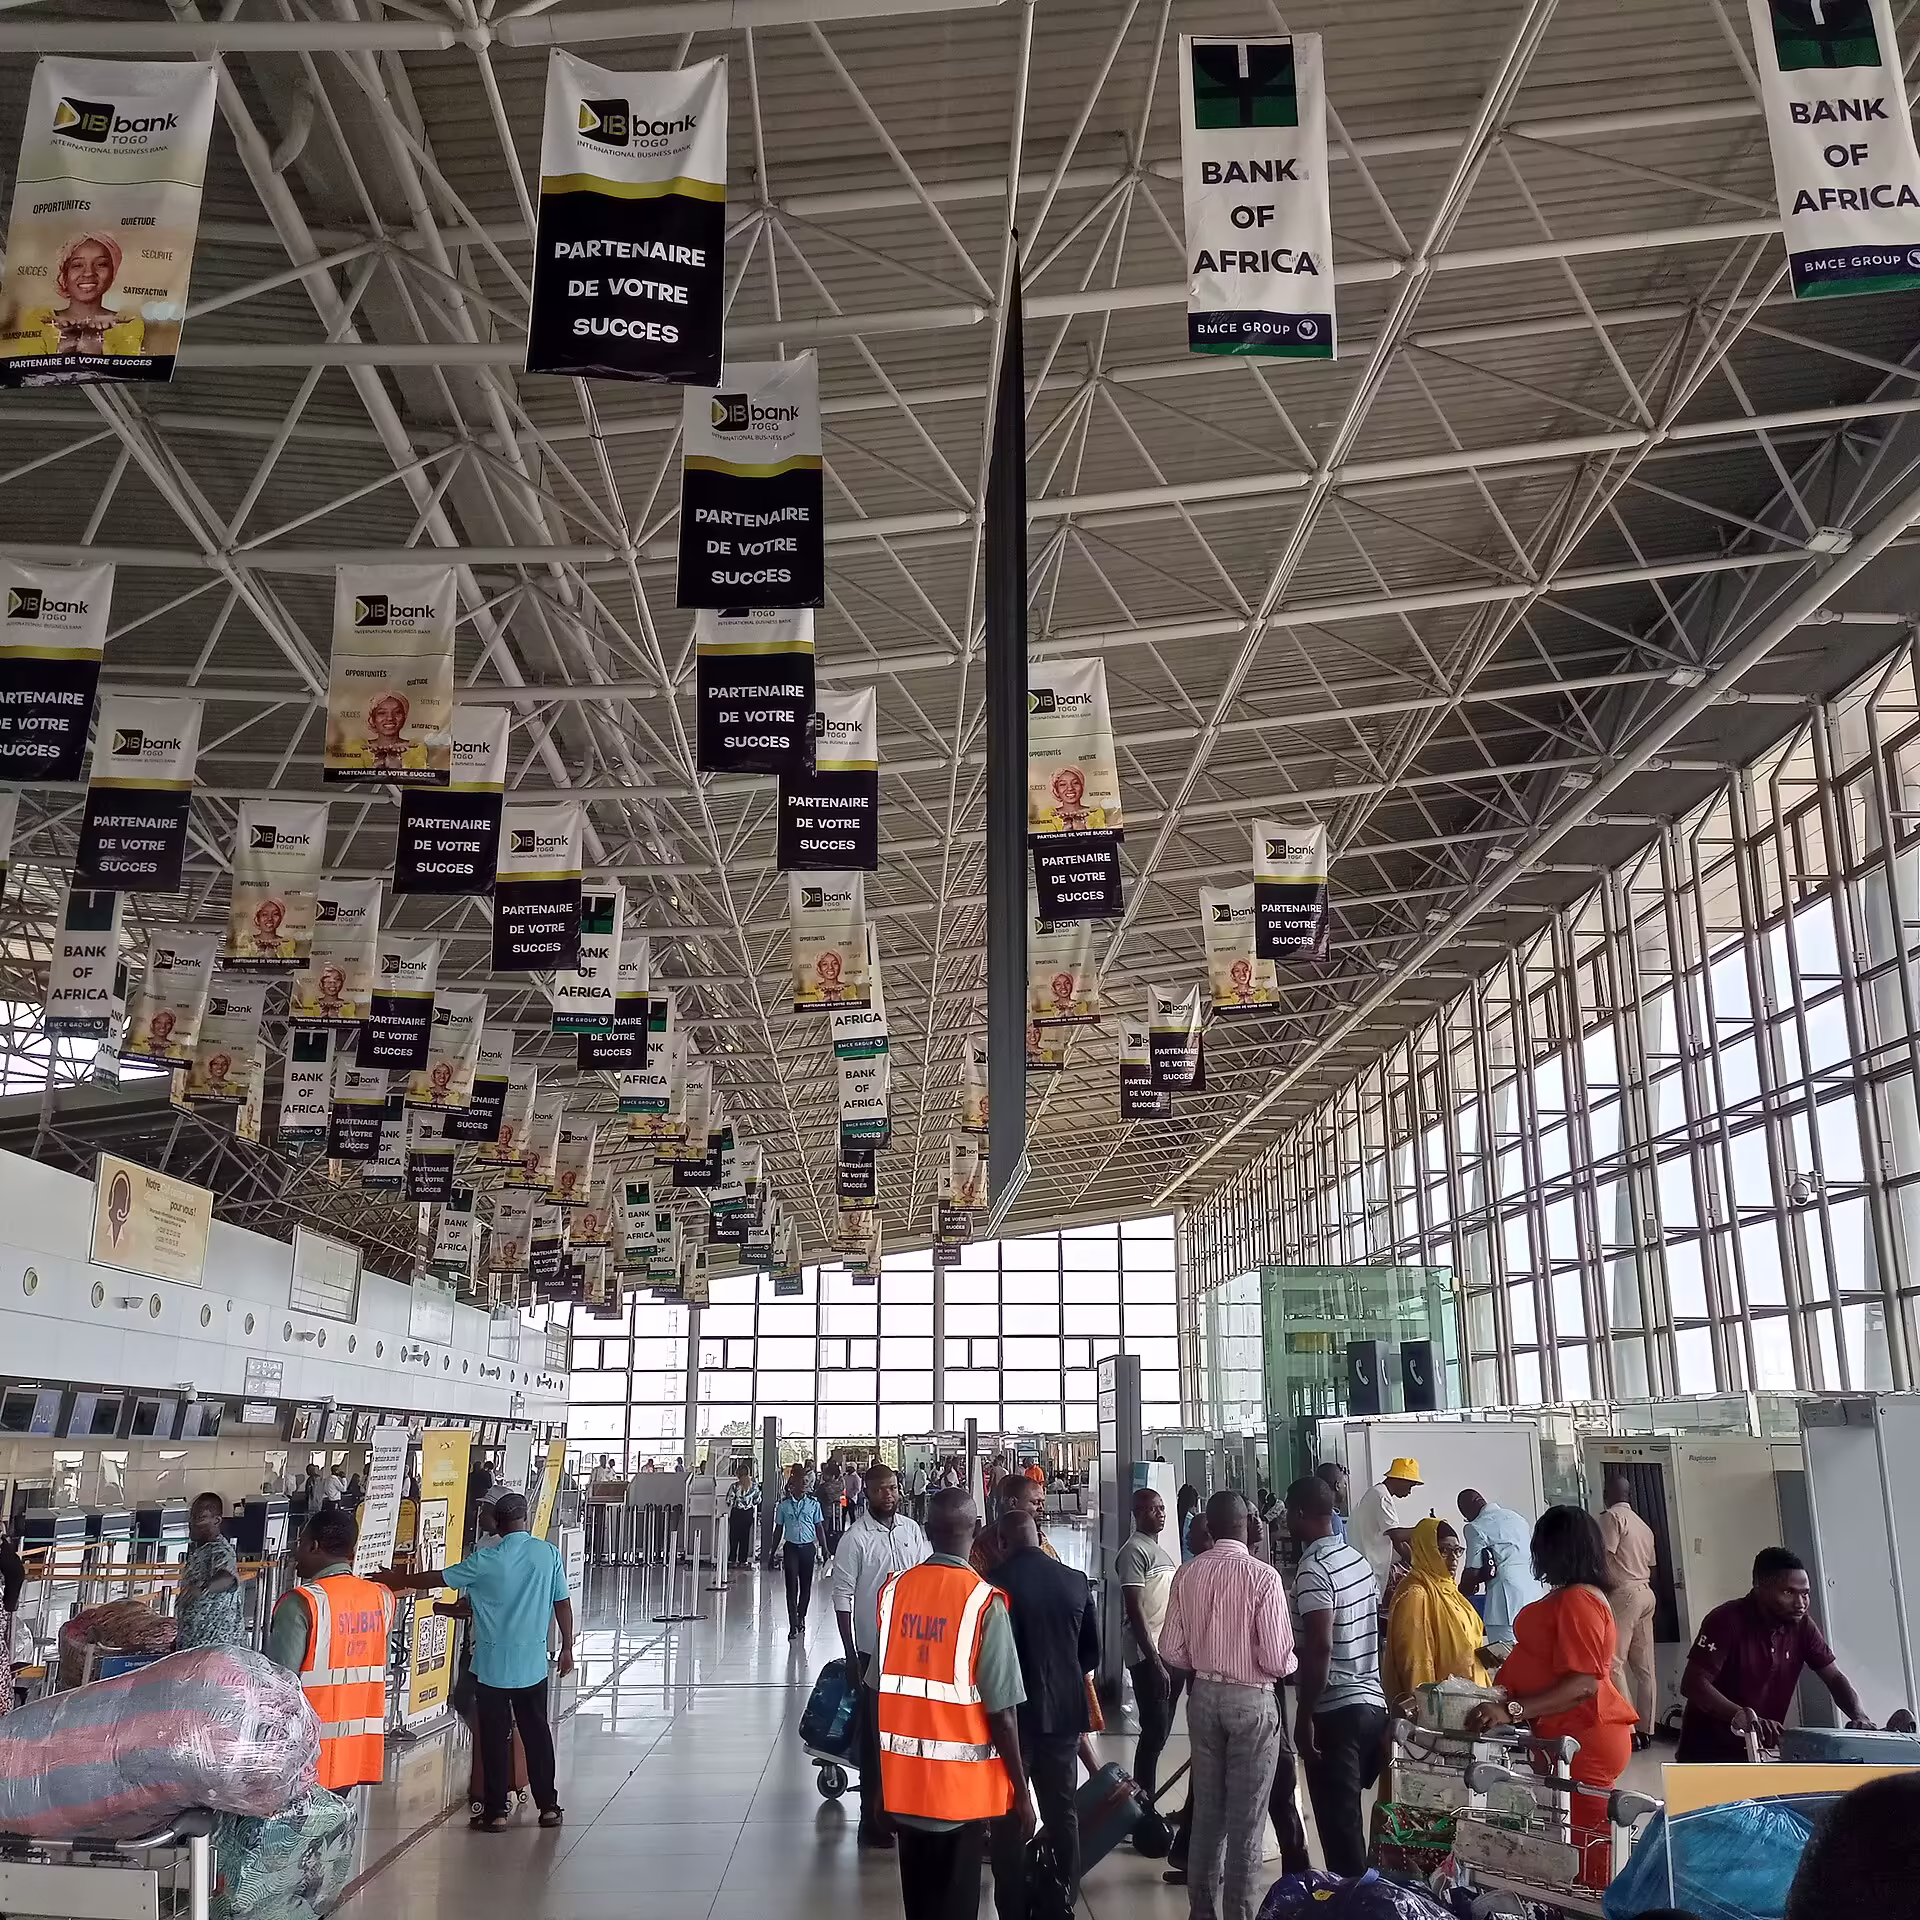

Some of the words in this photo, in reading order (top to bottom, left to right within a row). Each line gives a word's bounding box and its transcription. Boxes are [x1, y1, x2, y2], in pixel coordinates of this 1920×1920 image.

[1790, 98, 1889, 124] BANK
[112, 136, 147, 144] TOGO
[632, 139, 669, 147] TOGO
[50, 139, 112, 154] INTERNATIONAL
[576, 140, 634, 158] INTERNATIONAL
[636, 150, 672, 158] BUSINESS
[673, 144, 692, 154] BANK
[1824, 143, 1868, 167] OF
[1201, 158, 1298, 185] BANK
[1792, 184, 1920, 215] AFRICA
[1230, 205, 1274, 229] OF
[555, 240, 706, 268] PARTENAIRE
[1192, 249, 1319, 276] AFRICA
[1805, 259, 1846, 272] BMCE
[1852, 255, 1902, 267] GROUP
[123, 286, 168, 296] SATISFACTION
[568, 280, 598, 297] DE
[608, 278, 688, 305] VOTRE
[573, 317, 679, 344] SUCCES
[1198, 322, 1237, 334] BMCE
[1243, 321, 1290, 335] GROUP
[10, 358, 62, 368] PARTENAIRE
[65, 357, 76, 365] DE
[79, 357, 110, 365] VOTRE
[752, 423, 779, 431] TOGO
[696, 507, 809, 527] PARTENAIRE
[707, 540, 731, 555] DE
[738, 538, 797, 556] VOTRE
[711, 569, 792, 584] SUCCES
[42, 613, 67, 621] TOGO
[708, 685, 804, 698] PARTENAIRE
[0, 691, 84, 706] ARTENAIRE
[719, 712, 739, 723] DE
[744, 710, 794, 722] VOTRE
[17, 717, 70, 732] VOTRE
[724, 736, 790, 748] SUCCES
[788, 796, 868, 808] PARTENAIRE
[94, 816, 178, 830] PARTENAIRE
[407, 817, 491, 830] PARTENAIRE
[796, 818, 813, 829] DE
[817, 818, 860, 829] VOTRE
[98, 838, 116, 850] DE
[121, 839, 166, 852] VOTRE
[414, 839, 431, 850] DE
[436, 841, 480, 852] VOTRE
[800, 840, 856, 850] SUCCES
[1042, 852, 1111, 866] PARTENAIRE
[99, 862, 157, 873] SUCCES
[416, 862, 474, 874] SUCCES
[1051, 874, 1066, 884] DE
[1069, 871, 1106, 883] VOTRE
[1056, 891, 1104, 903] SUCCES
[502, 903, 573, 915] PARTENAIRE
[1262, 904, 1322, 913] PARTENAIRE
[509, 924, 524, 934] DE
[528, 922, 565, 933] VOTRE
[1268, 921, 1282, 929] DE
[1284, 921, 1316, 929] VOTRE
[1272, 936, 1314, 945] SUCCES
[64, 946, 107, 957] BANK
[512, 943, 561, 953] SUCCES
[72, 967, 93, 978] OF
[52, 988, 108, 1001] AFRICA
[558, 986, 612, 998] AFRICA
[368, 1015, 426, 1025] PARTENAIRE
[835, 1013, 882, 1026] AFRICA
[606, 1033, 635, 1041] VOTRE
[373, 1047, 413, 1056] SUCCES
[593, 1048, 632, 1056] SUCCES
[291, 1073, 323, 1082] BANK
[624, 1075, 667, 1084] AFRICA
[846, 1069, 876, 1079] BANK
[298, 1089, 314, 1097] OF
[855, 1084, 869, 1092] OF
[844, 1098, 883, 1108] AFRICA
[284, 1105, 325, 1114] AFRICA
[468, 1109, 493, 1117] VOTRE
[336, 1118, 378, 1126] PARTENAIRE
[457, 1122, 488, 1130] SUCCES
[340, 1142, 369, 1150] SUCCES
[146, 1177, 160, 1191] Notre
[628, 1210, 650, 1218] BANK
[444, 1219, 468, 1228] BANK
[634, 1221, 645, 1229] OF
[626, 1232, 655, 1240] AFRICA
[437, 1243, 467, 1252] AFRICA
